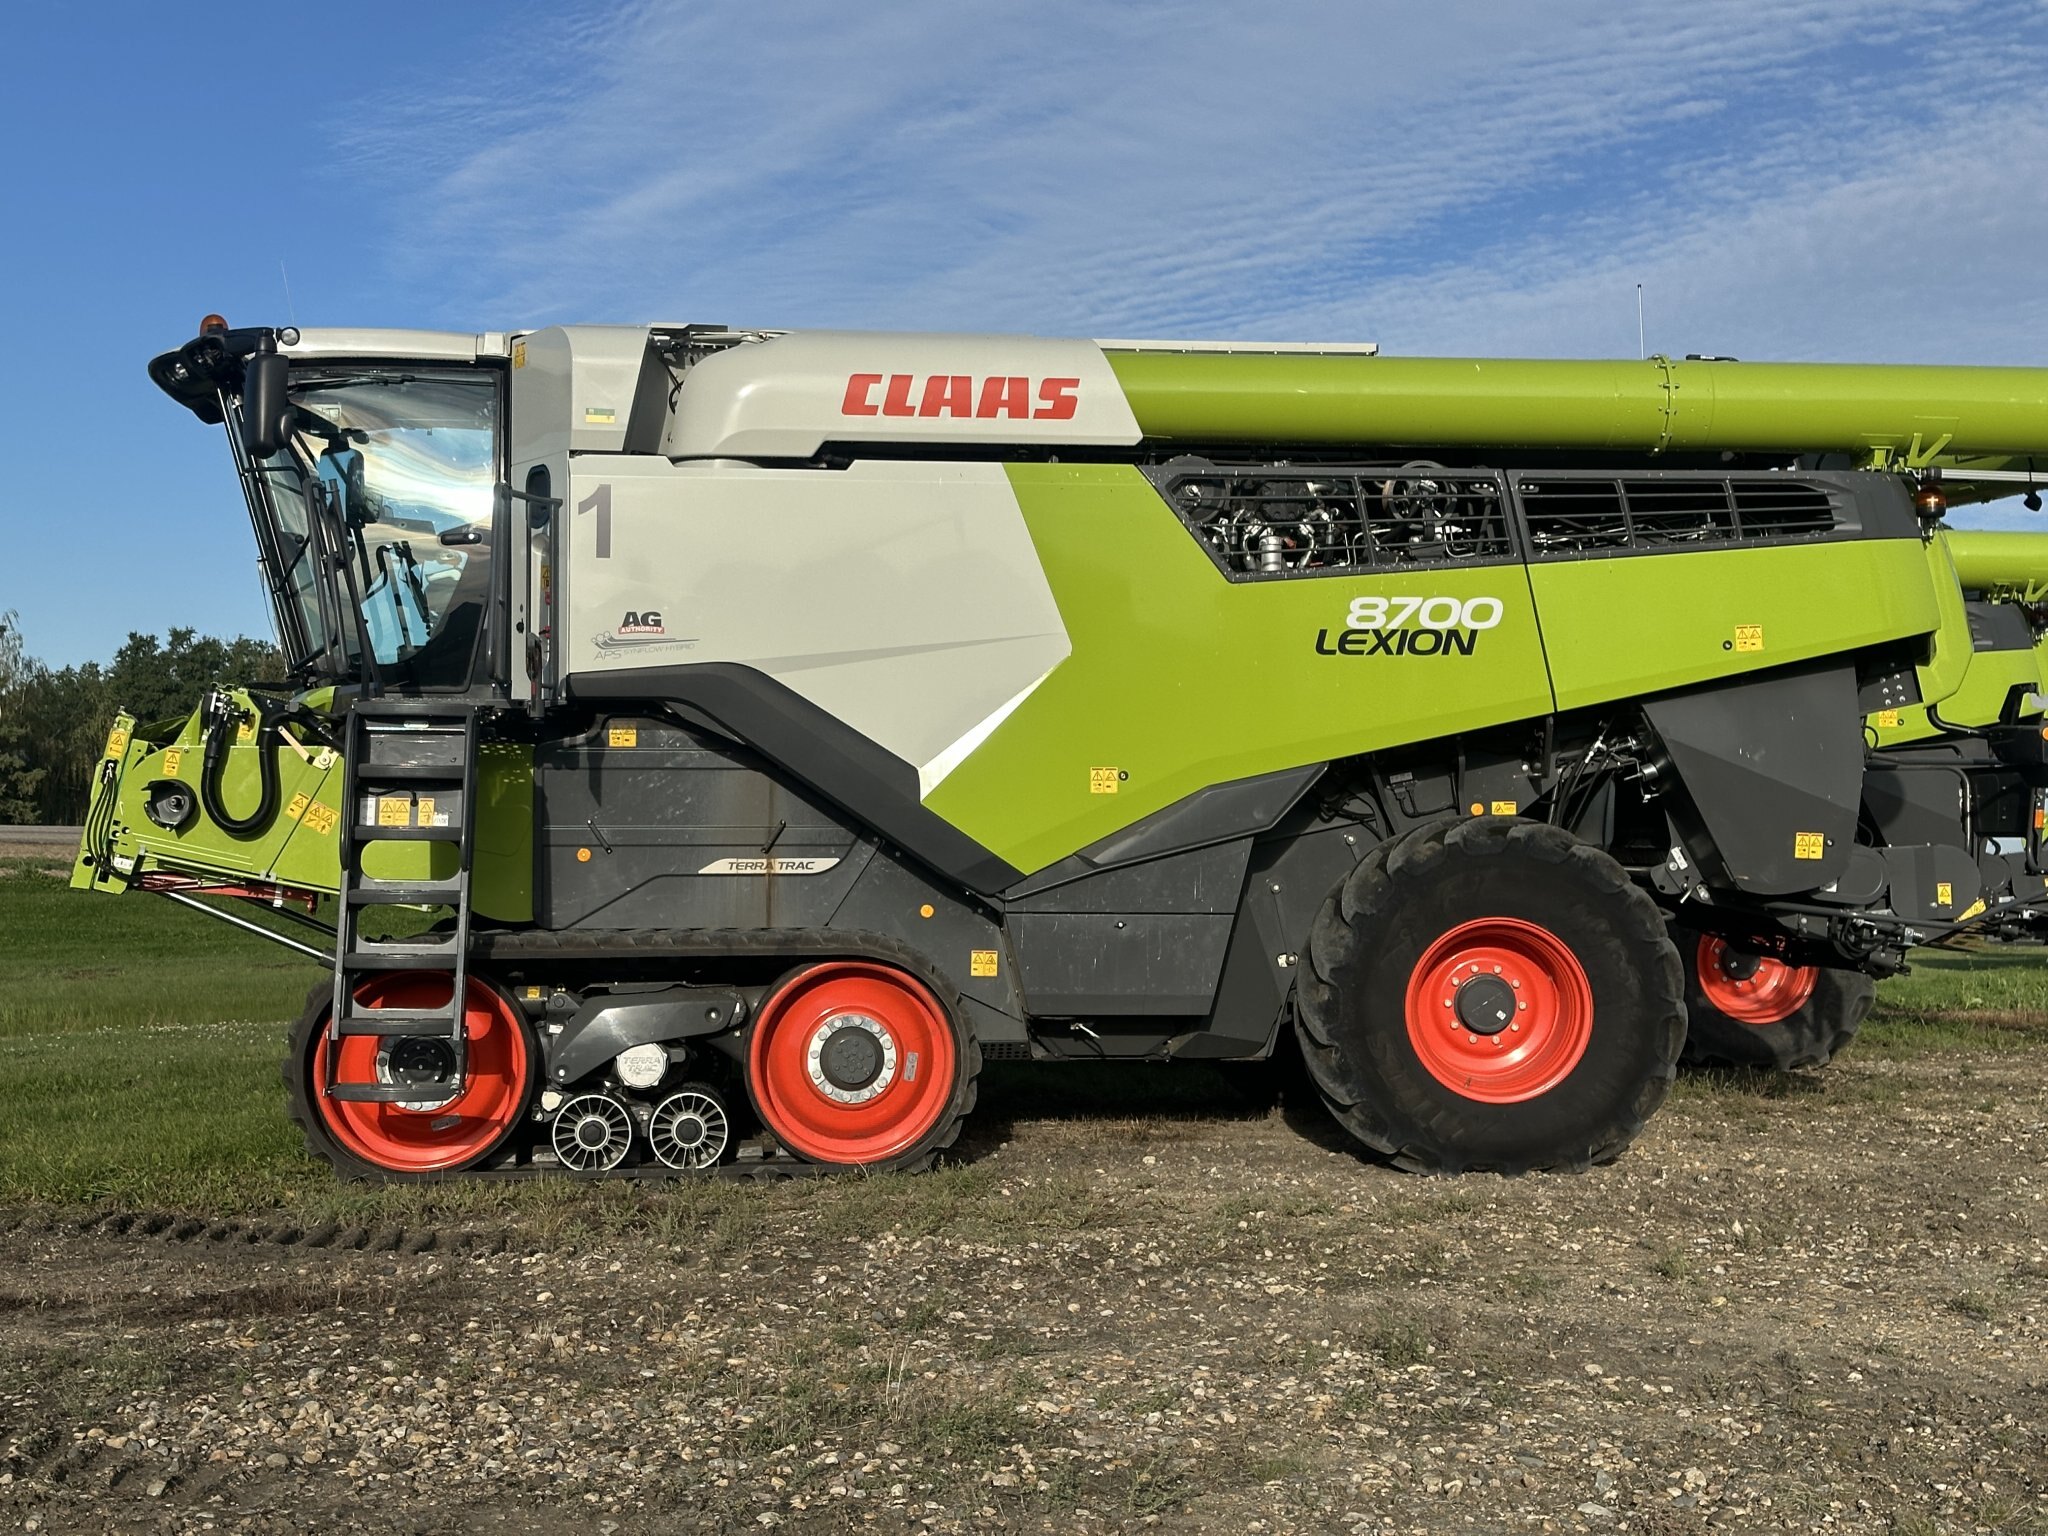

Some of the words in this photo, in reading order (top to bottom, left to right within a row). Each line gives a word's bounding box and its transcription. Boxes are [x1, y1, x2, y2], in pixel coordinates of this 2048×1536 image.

[841, 373, 1080, 420] CLAAS
[578, 483, 612, 559] 1
[621, 611, 662, 627] AG
[1346, 596, 1504, 630] 8700
[1315, 628, 1478, 656] LEXION
[594, 649, 622, 661] APS
[623, 646, 664, 655] SYNFLOW
[665, 643, 696, 652] HYBRID
[728, 861, 774, 871] TERRA
[777, 861, 816, 871] TRAC
[623, 1056, 661, 1065] TERRA
[627, 1064, 658, 1072] TRAC
